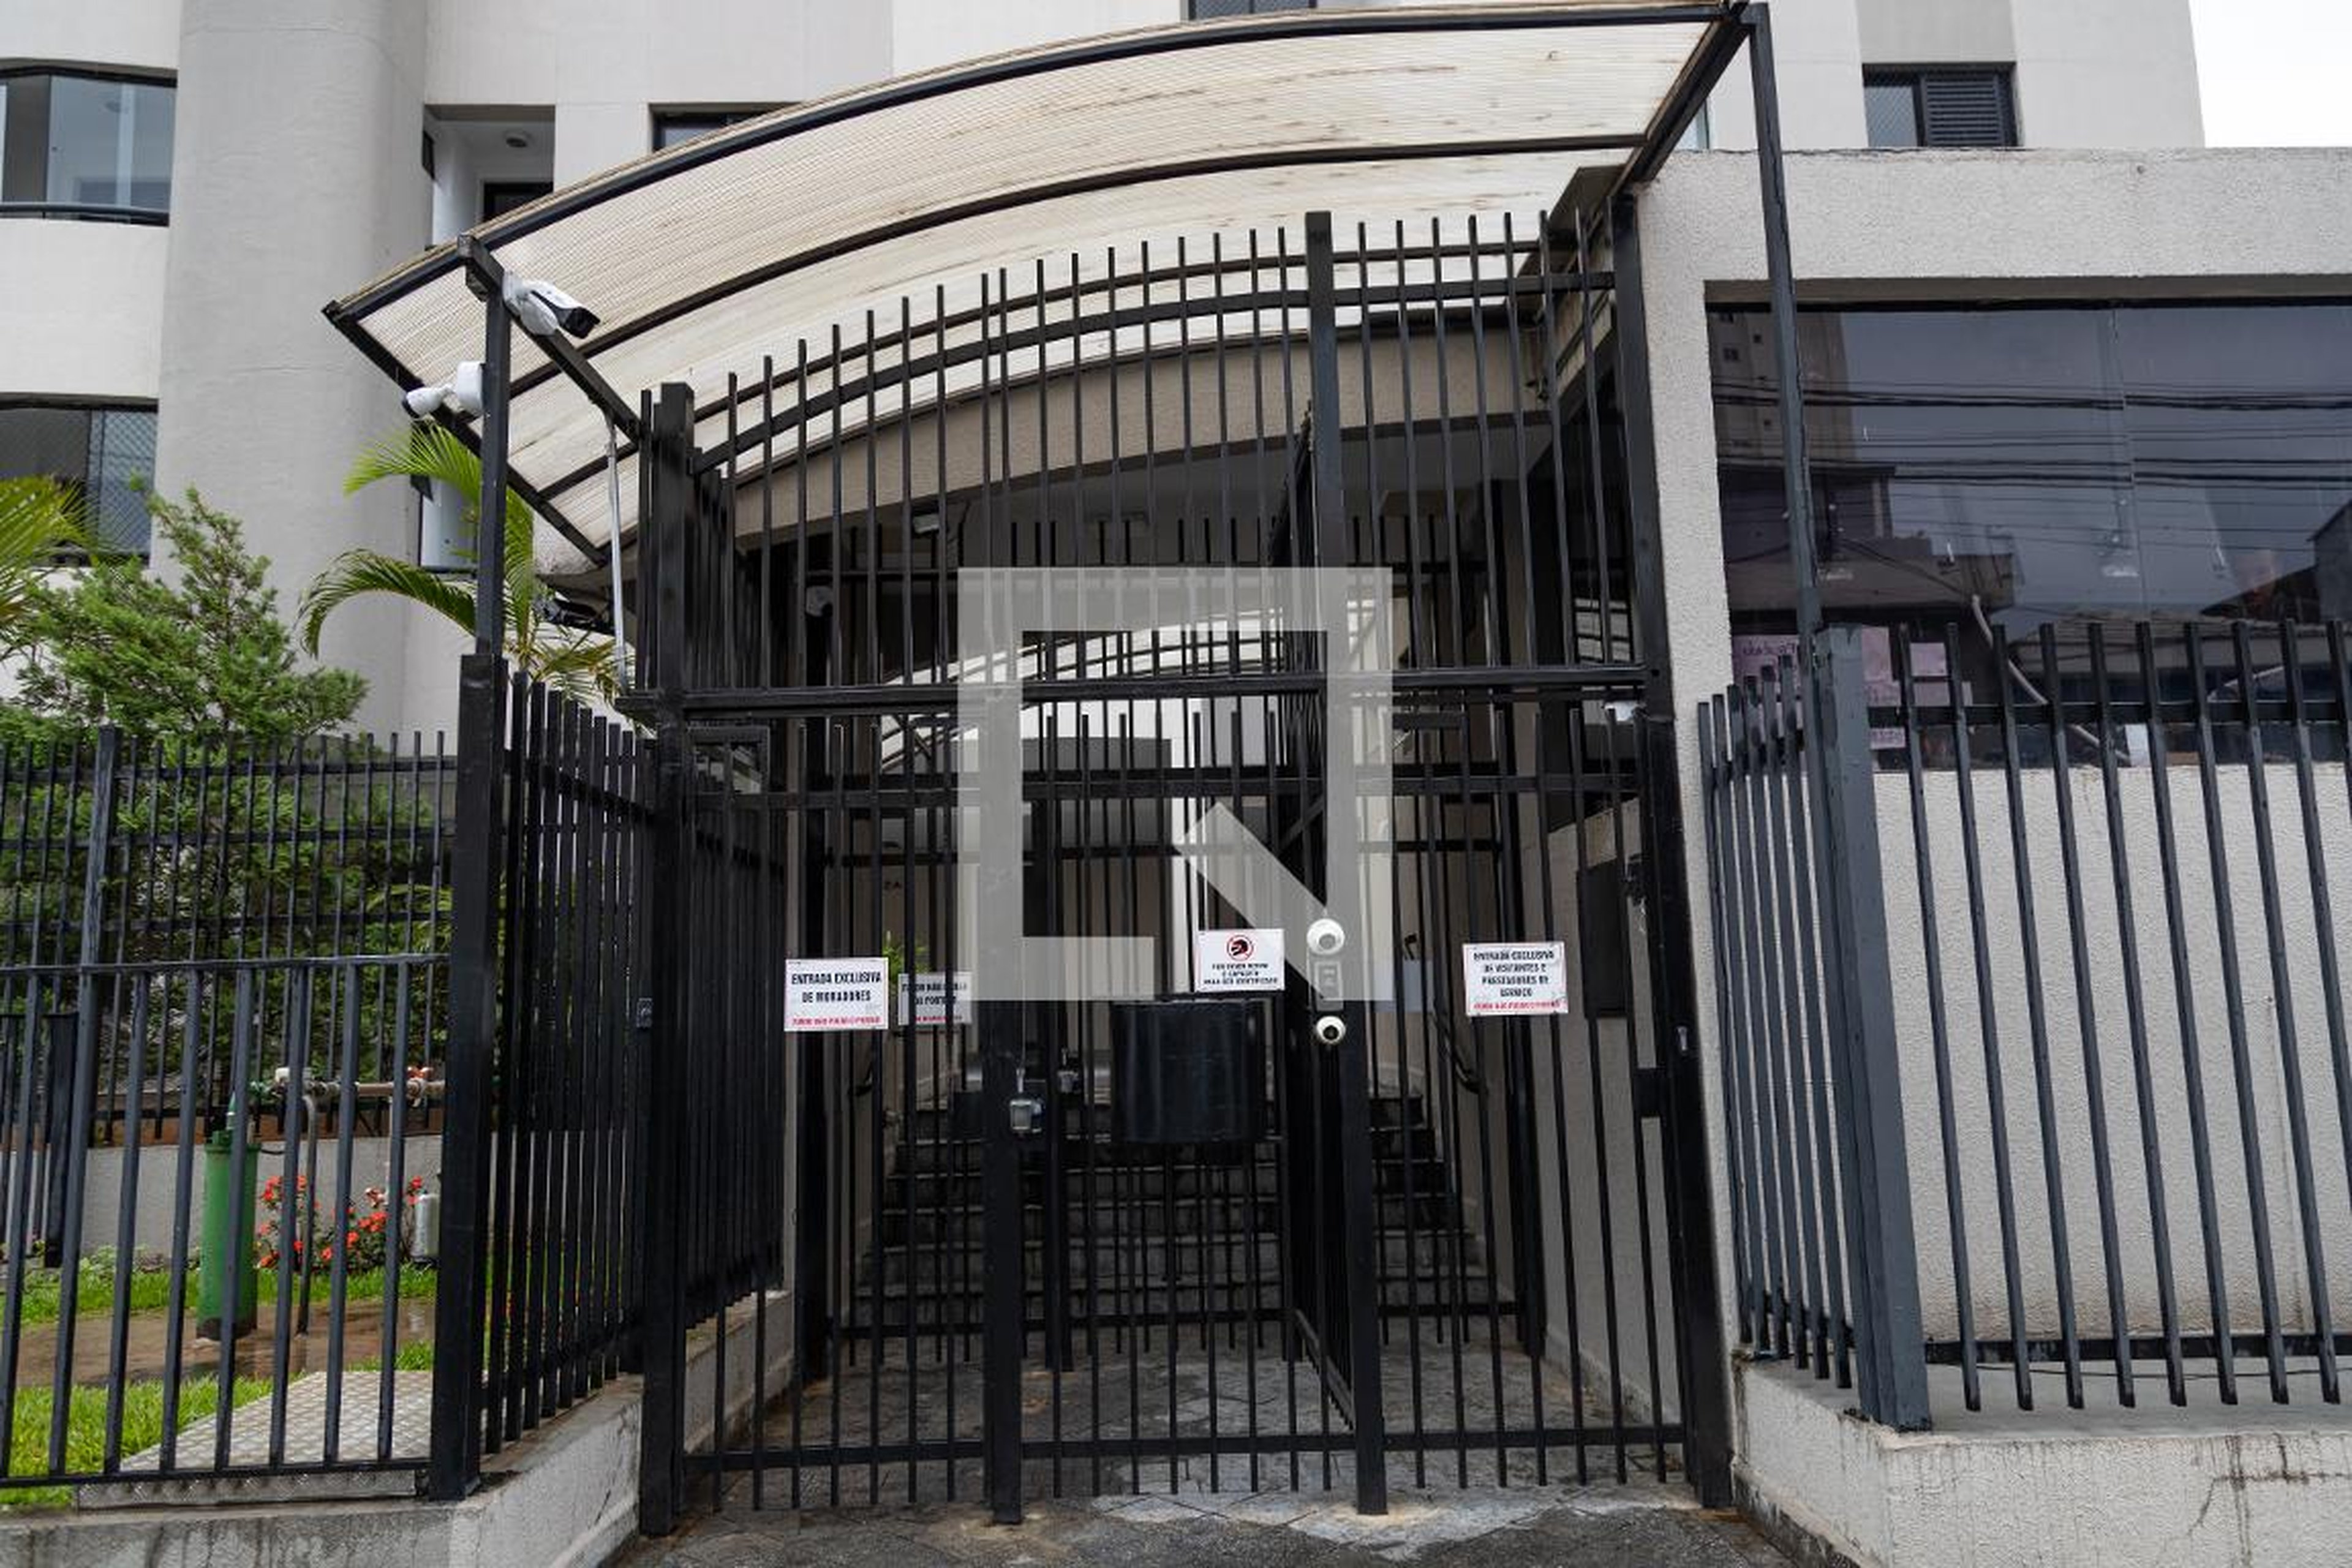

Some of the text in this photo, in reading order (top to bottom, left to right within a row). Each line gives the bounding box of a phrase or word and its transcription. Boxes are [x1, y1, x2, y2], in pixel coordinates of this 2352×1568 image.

[791, 971, 881, 985] ENTRADA EXCLUSIVA
[802, 990, 871, 1003] DE MORADORES
